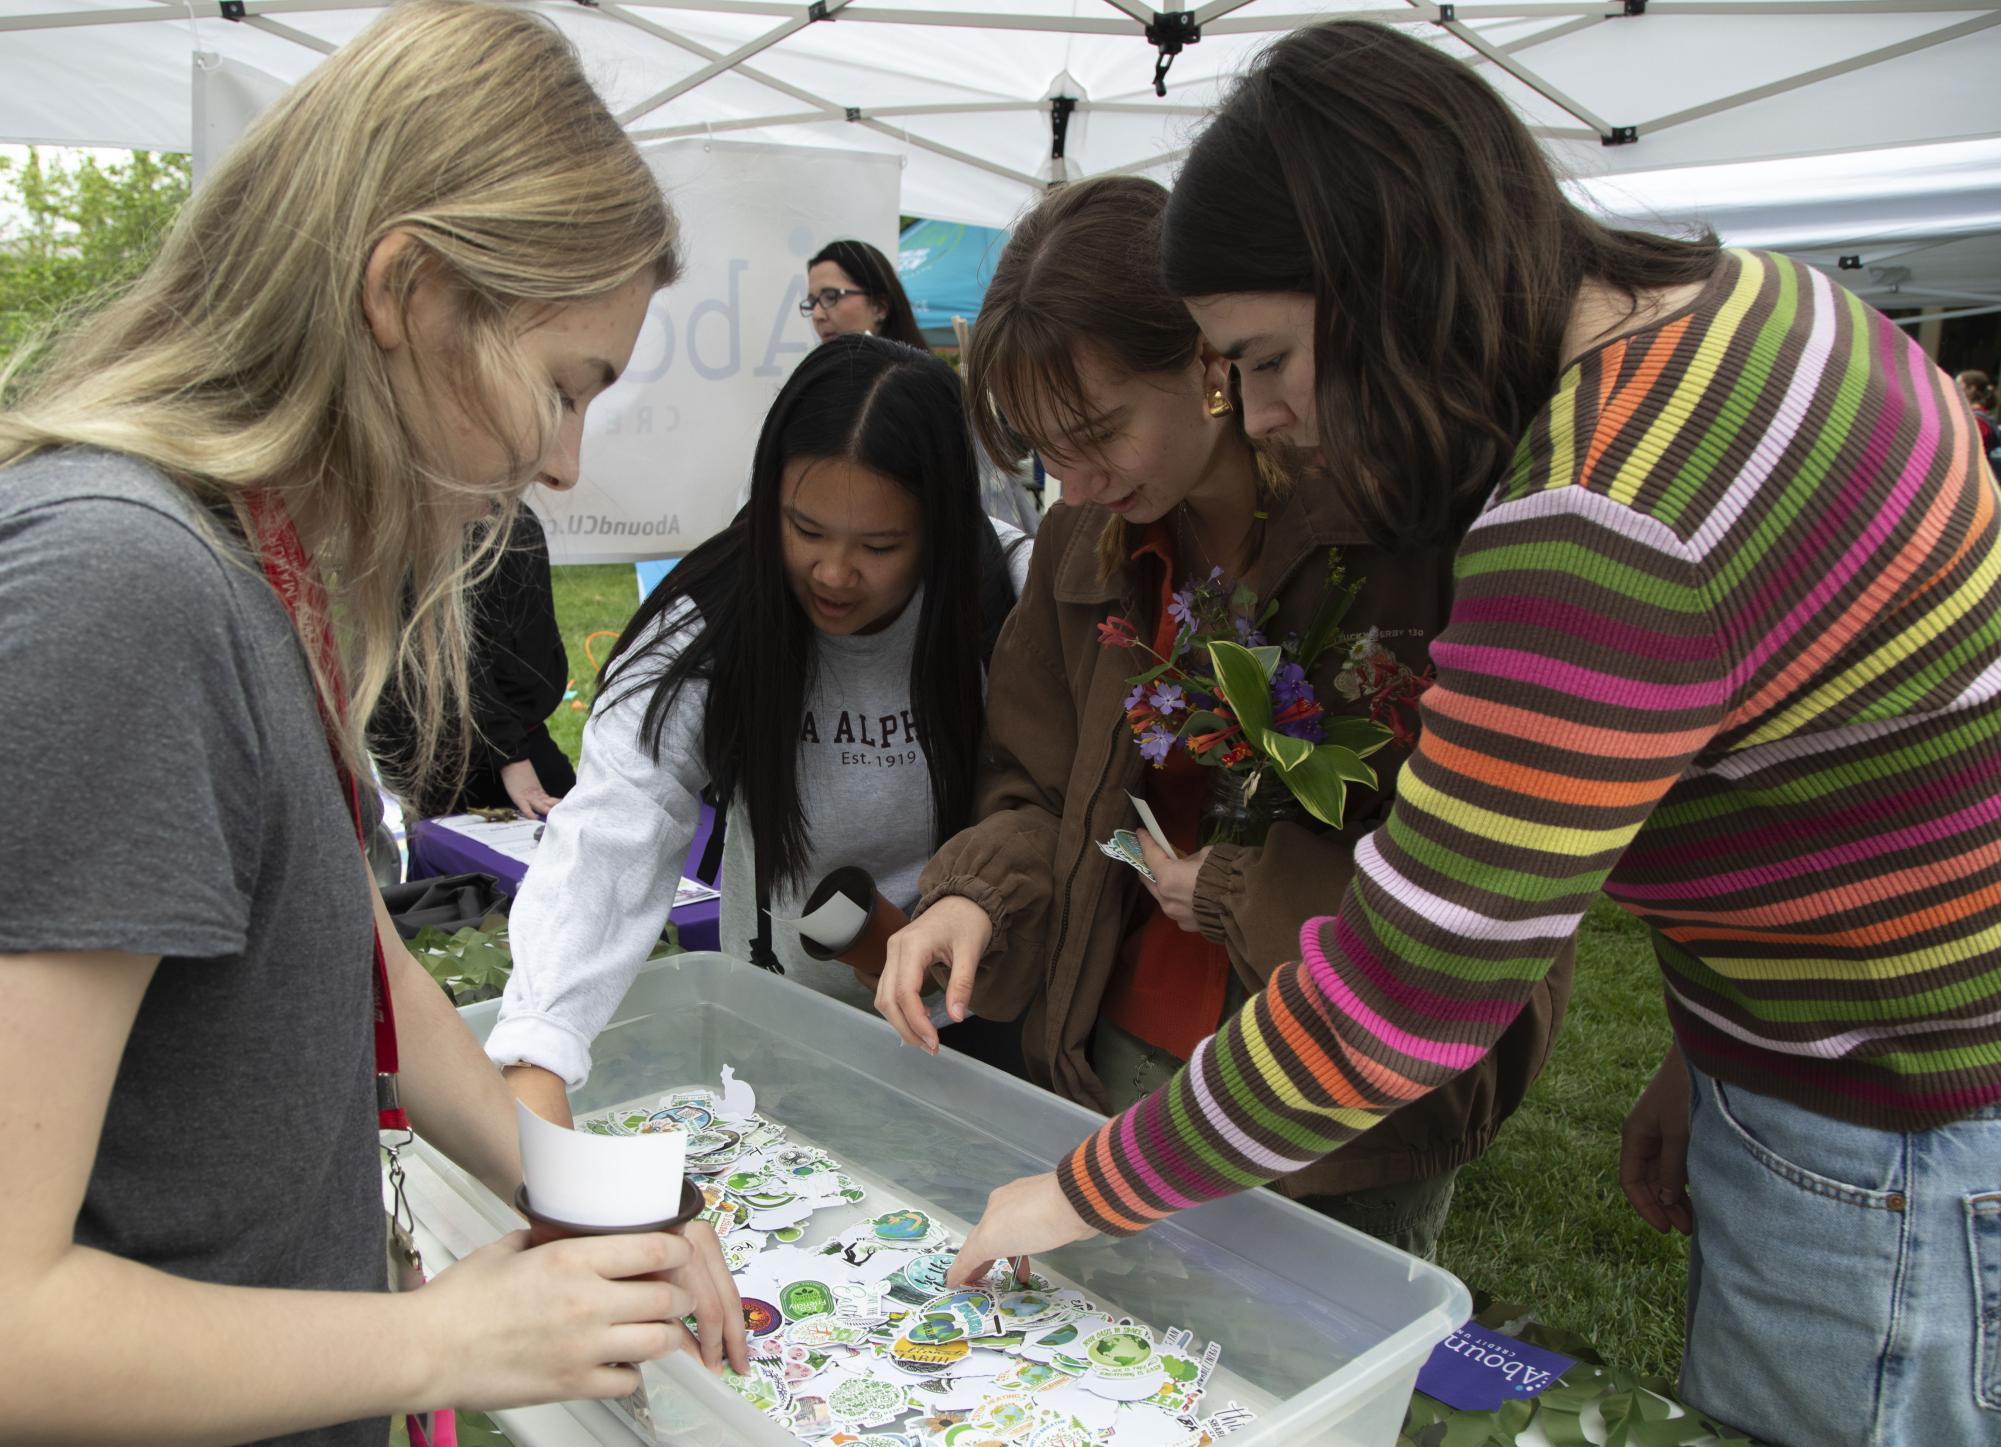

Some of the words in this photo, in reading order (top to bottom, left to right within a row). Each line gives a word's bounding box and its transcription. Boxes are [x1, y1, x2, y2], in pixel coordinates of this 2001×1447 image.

[842, 751, 871, 765] Est.
[876, 751, 916, 767] 1919
[1474, 1338, 1517, 1358] CREDIT
